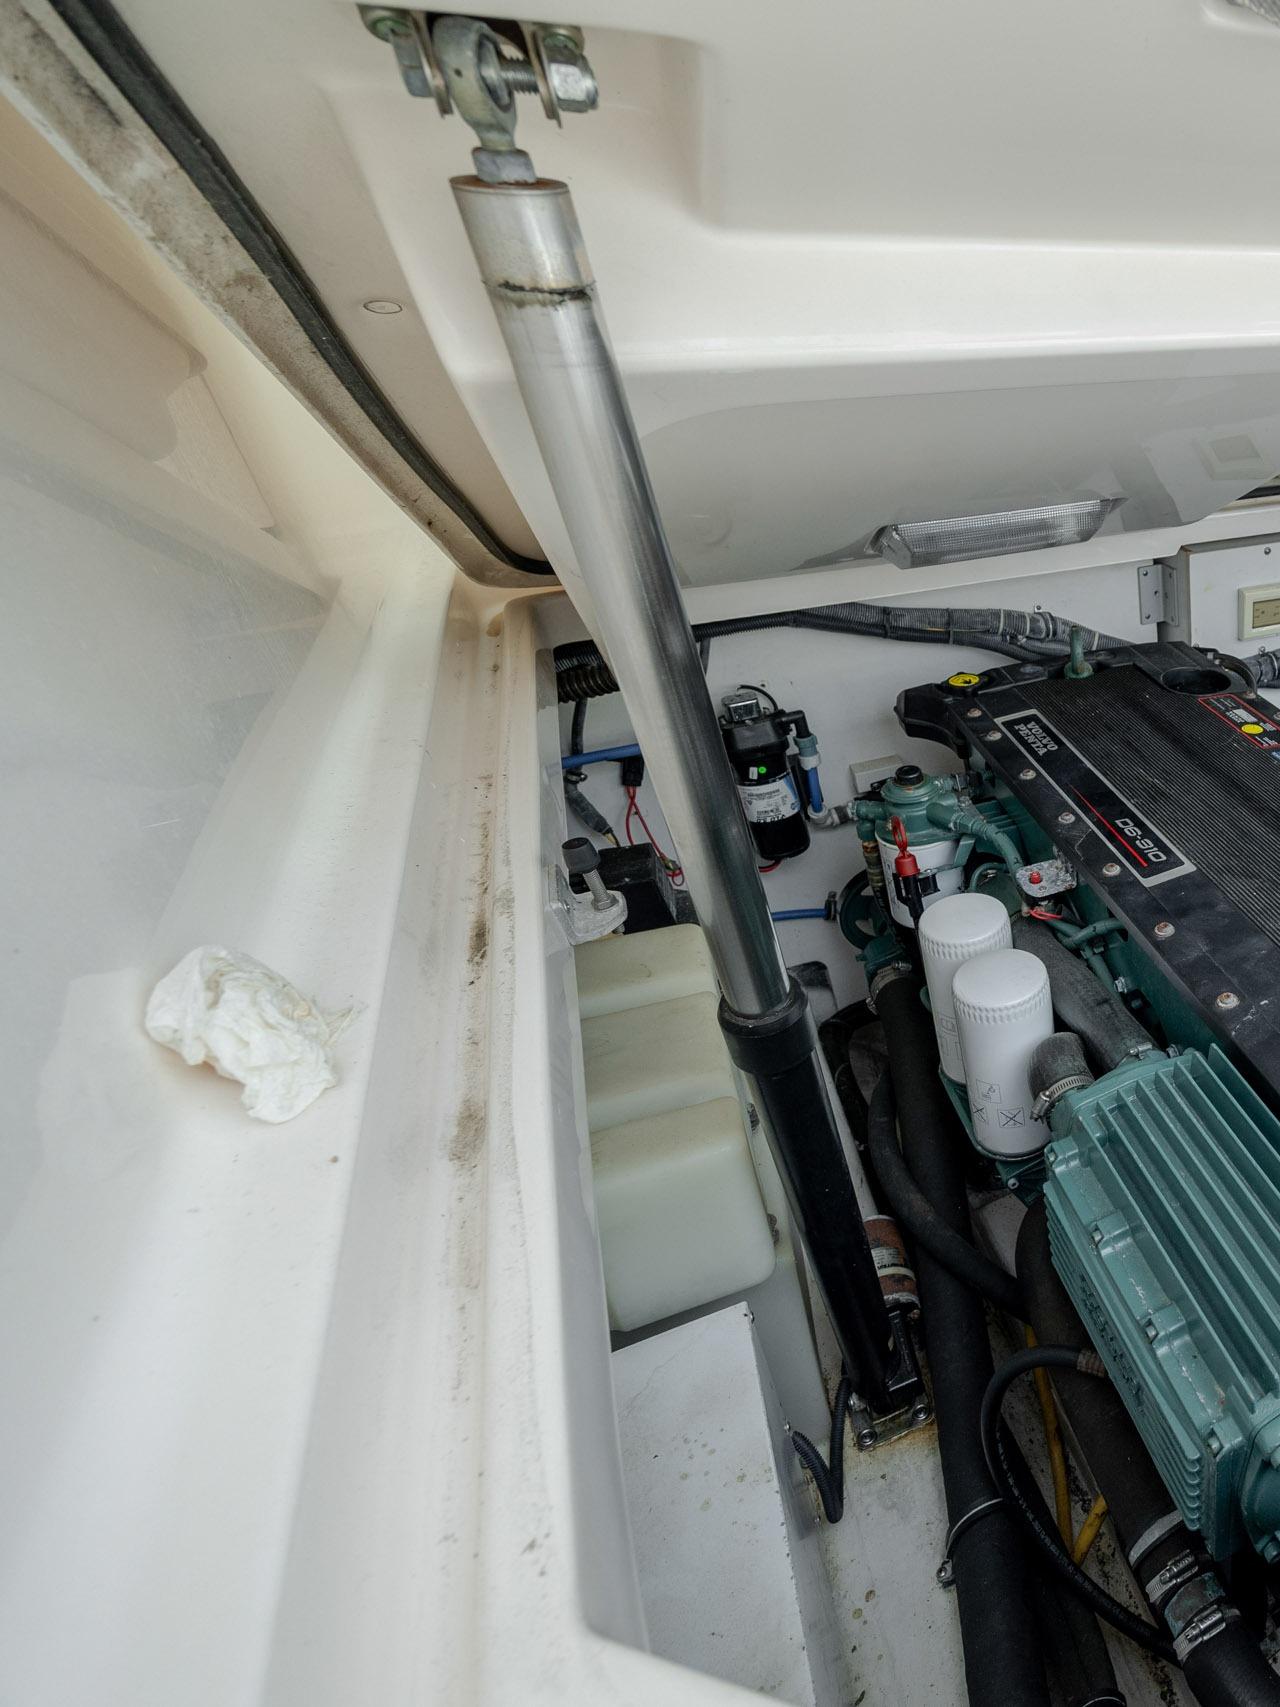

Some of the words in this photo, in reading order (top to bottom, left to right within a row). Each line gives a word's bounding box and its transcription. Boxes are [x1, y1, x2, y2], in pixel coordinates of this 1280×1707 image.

[1014, 723, 1048, 756] PENTA
[1026, 721, 1058, 751] VOLVO
[1115, 818, 1167, 862] D6-310
